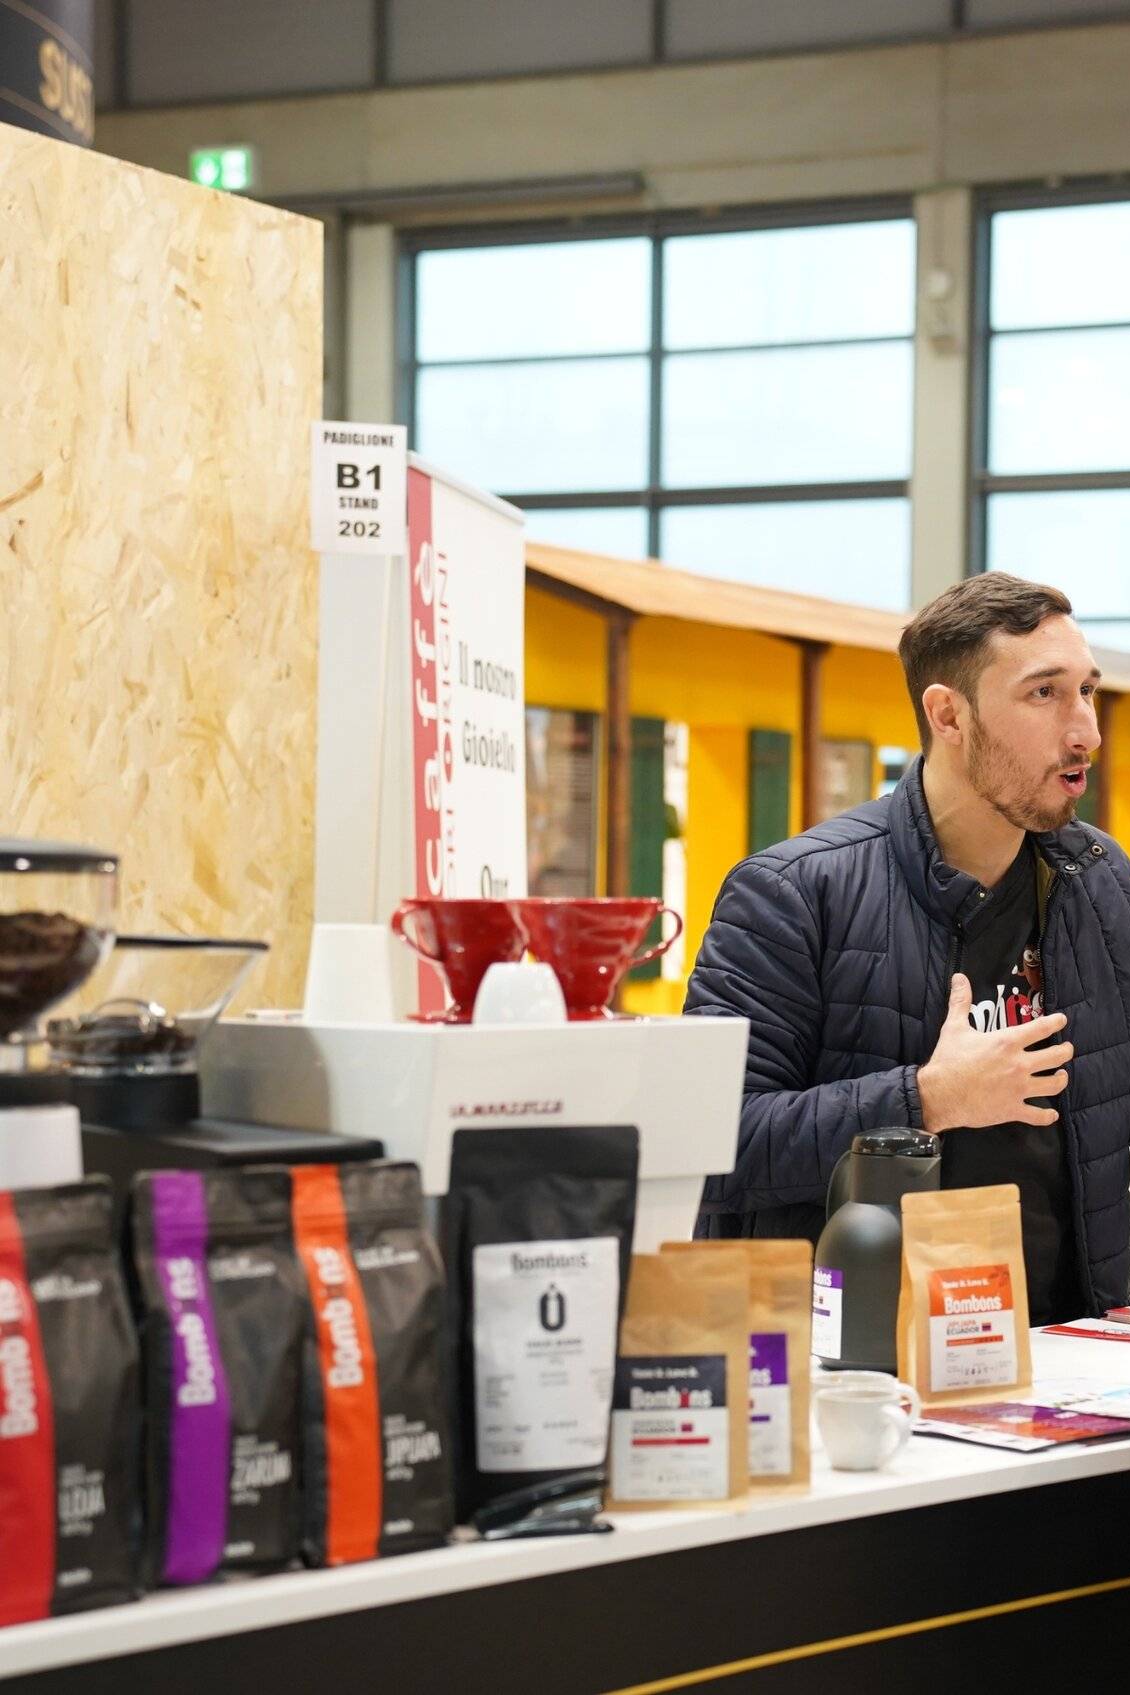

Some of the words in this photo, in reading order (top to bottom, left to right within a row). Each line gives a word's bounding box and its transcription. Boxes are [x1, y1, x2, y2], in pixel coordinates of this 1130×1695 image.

[323, 431, 395, 447] PADIGLIONE
[336, 463, 382, 490] B1
[338, 496, 379, 509] STAND
[338, 520, 381, 537] 202
[473, 657, 516, 701] nostro
[462, 720, 516, 774] Gioiello
[943, 1294, 1003, 1315] Bombons
